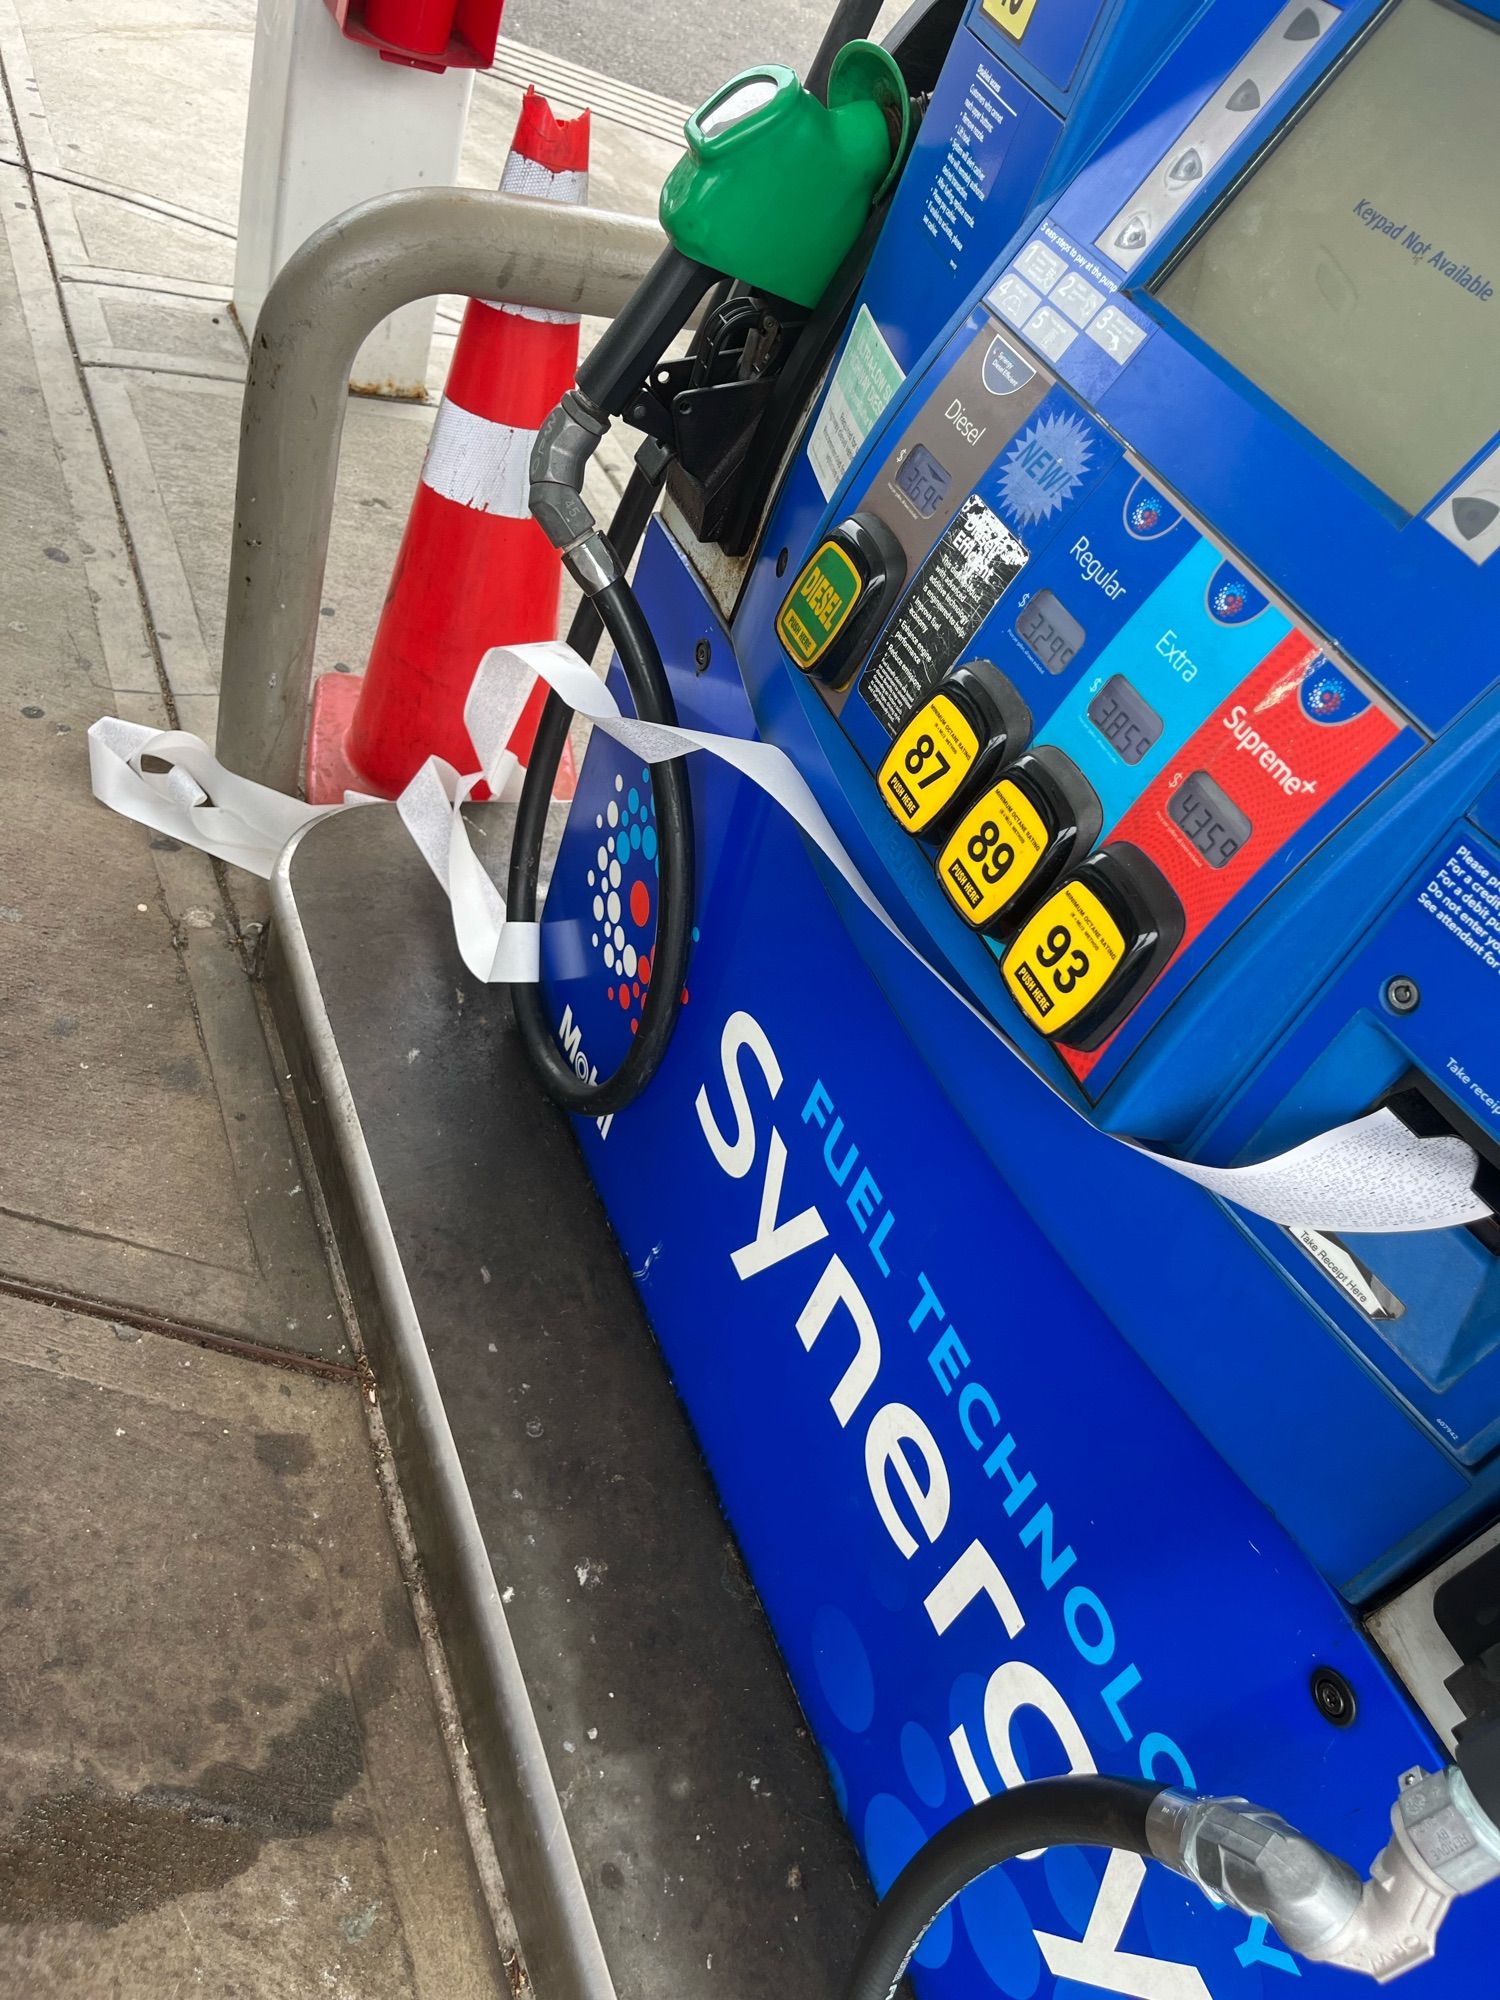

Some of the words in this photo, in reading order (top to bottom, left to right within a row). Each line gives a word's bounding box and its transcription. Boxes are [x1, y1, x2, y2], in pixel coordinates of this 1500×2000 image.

[1025, 245, 1039, 262] 1
[1042, 227, 1057, 242] easy
[1054, 236, 1072, 253] steps
[1068, 248, 1077, 257] to
[1073, 253, 1087, 267] pay
[1084, 261, 1094, 271] at
[1090, 266, 1103, 278] the
[1098, 274, 1118, 293] pump
[1352, 198, 1407, 240] Keypad
[1401, 231, 1432, 256] Not
[1427, 251, 1494, 301] Available
[999, 279, 1013, 297] 4
[1058, 276, 1075, 296] 2
[1032, 311, 1049, 329] 5
[1096, 309, 1113, 329] 3
[944, 398, 987, 446] Diesel
[896, 448, 907, 463] $
[1015, 439, 1074, 498] NEW!
[934, 564, 947, 578] with
[943, 575, 967, 602] advanced
[1070, 536, 1126, 600] Regular
[800, 566, 843, 632] DIESEL
[906, 608, 929, 633] economy
[912, 597, 934, 621] Improve
[930, 617, 941, 630] fuel
[924, 589, 952, 619] engineered
[927, 573, 948, 596] additive
[942, 593, 971, 625] technology
[1018, 592, 1030, 608] $
[789, 616, 802, 637] PUSH
[799, 631, 812, 652] HERE
[892, 630, 923, 664] performance
[899, 620, 920, 644] Enhance
[915, 642, 933, 662] engine
[1155, 629, 1198, 683] Extra
[886, 644, 905, 665] Reduce
[899, 663, 924, 690] emissions
[1089, 678, 1102, 692] $
[930, 704, 947, 726] MINIMUM
[945, 723, 960, 743] OCTANE
[959, 742, 971, 761] RATING
[1223, 705, 1317, 796] Supreme+
[905, 734, 951, 790] 87
[1168, 772, 1184, 789] $
[890, 776, 905, 797] PUSH
[901, 793, 916, 814] HERE
[994, 788, 1013, 814] MINIMUM
[1011, 811, 1027, 833] OCTANE
[1025, 831, 1041, 852] RATING
[967, 820, 1015, 884] 89
[1455, 845, 1490, 879] Please
[951, 863, 967, 885] PUSH
[964, 881, 980, 905] HERE
[1436, 869, 1456, 889] For
[1453, 886, 1463, 896] a
[1461, 893, 1490, 920] debit
[1446, 857, 1466, 877] For
[1463, 874, 1473, 884] a
[1471, 881, 1500, 911] credit
[1065, 890, 1086, 918] MINIMUM
[1083, 915, 1101, 940] OCTANE
[1099, 937, 1117, 961] RATING
[1417, 892, 1438, 913] See
[1435, 910, 1485, 956] attendant
[1482, 950, 1500, 969] for
[1427, 880, 1444, 899] Do
[1441, 896, 1463, 915] not
[1459, 912, 1489, 938] enter
[1484, 935, 1500, 954] yo
[1036, 924, 1090, 994] 93
[1018, 967, 1036, 992] PUSH
[1031, 987, 1050, 1012] HERE
[559, 1003, 614, 1141] Mol
[1446, 1056, 1471, 1085] Take
[1300, 1230, 1319, 1252] Take
[1317, 1251, 1350, 1288] Receipt
[1347, 1280, 1368, 1303] Here
[801, 1078, 896, 1279] FUEL
[908, 1271, 1302, 1977] TECHNOLOY
